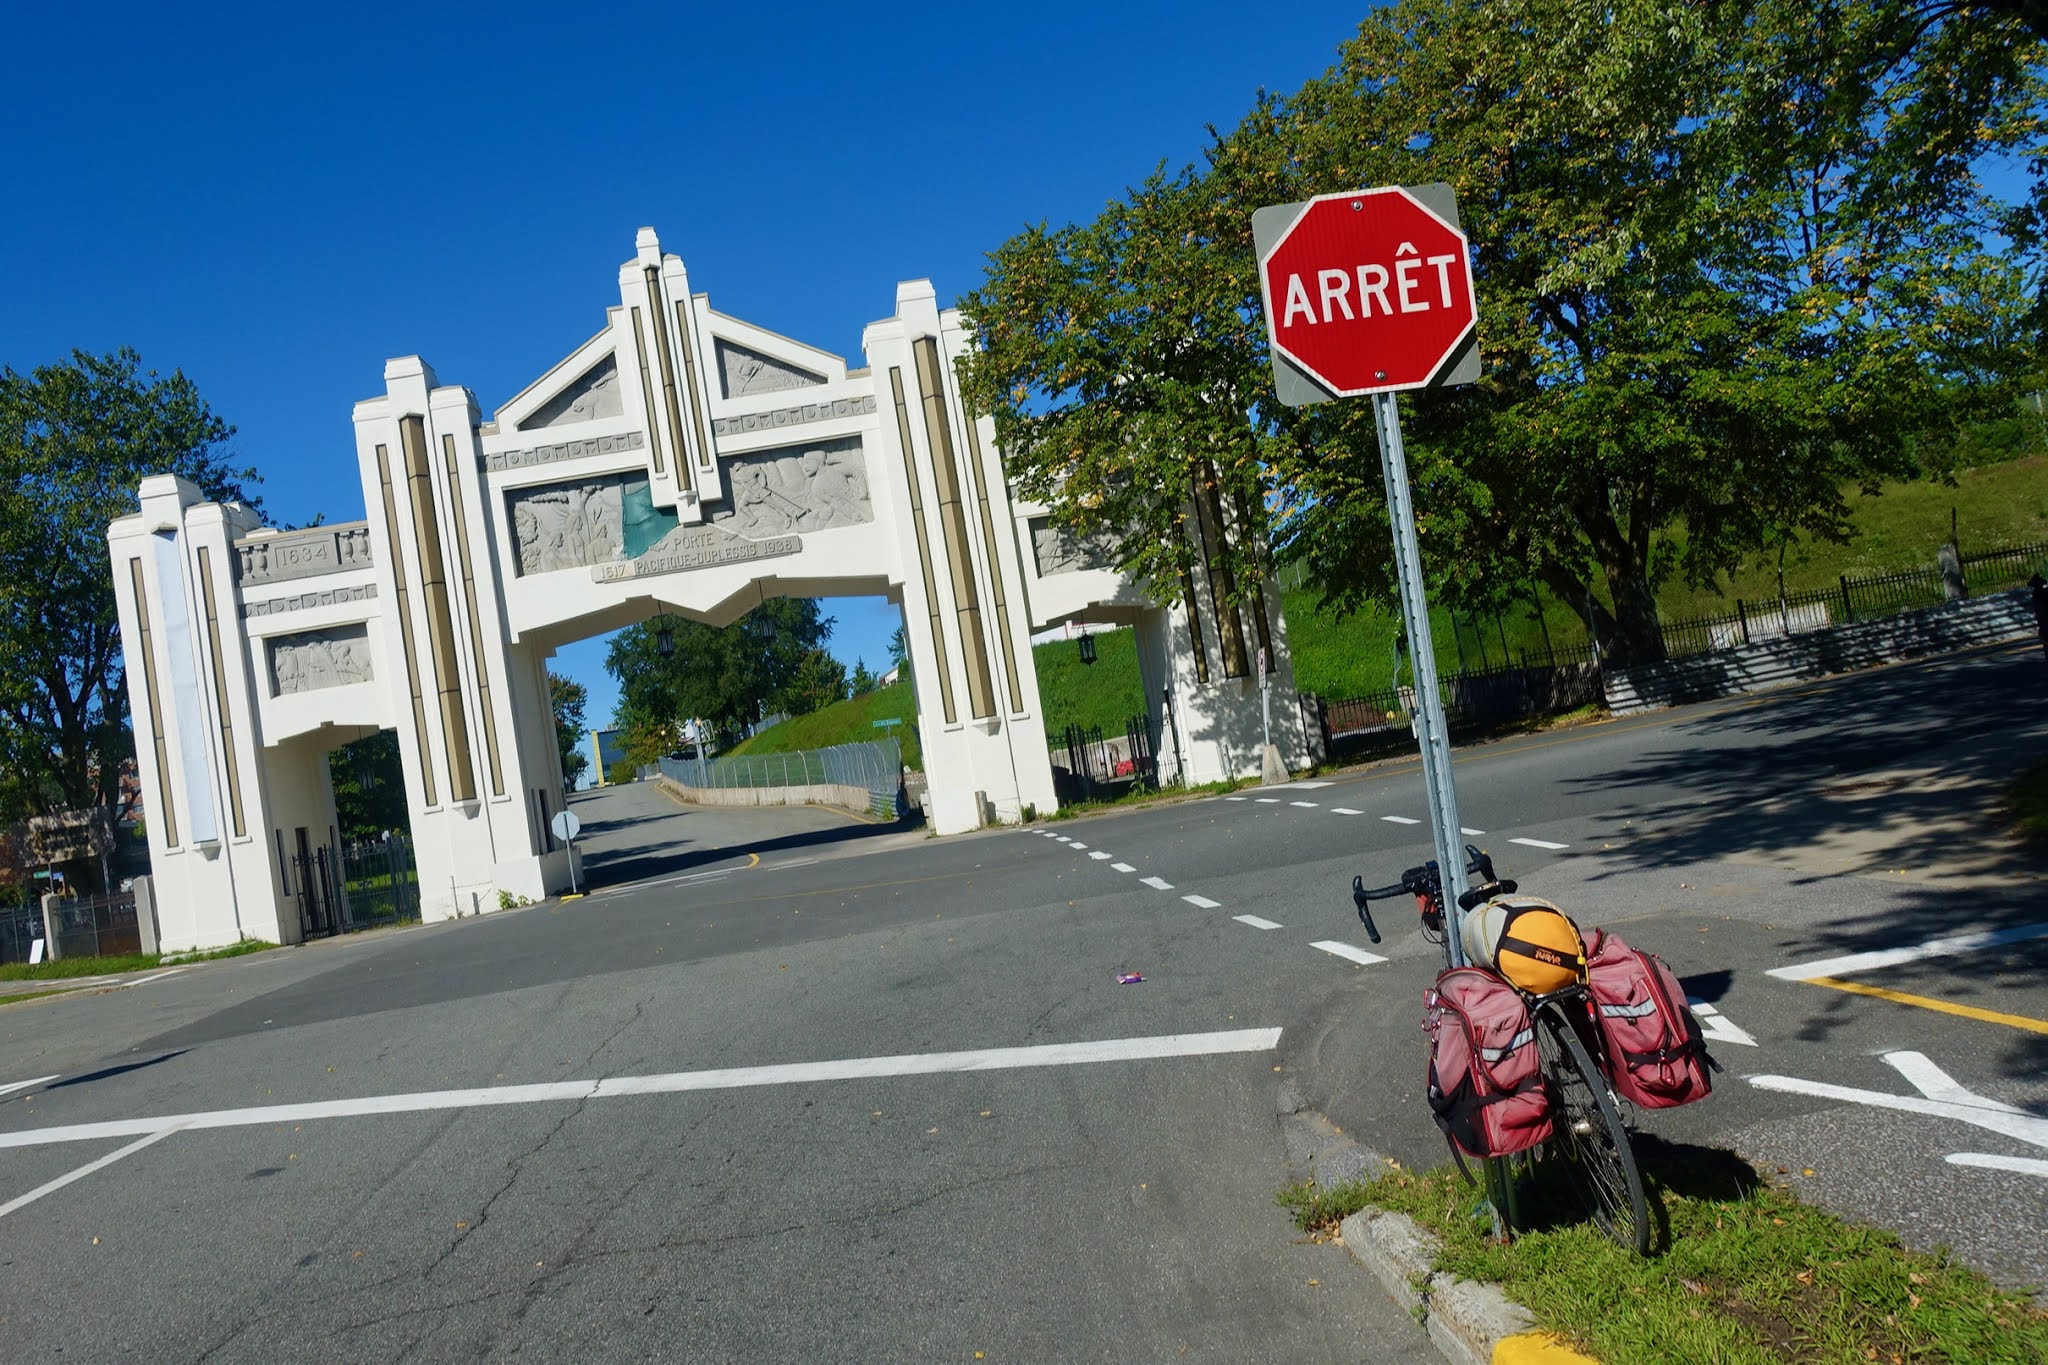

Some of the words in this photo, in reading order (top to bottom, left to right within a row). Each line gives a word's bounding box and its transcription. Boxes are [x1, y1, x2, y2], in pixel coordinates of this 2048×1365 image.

[1283, 241, 1456, 328] ARRÊT
[282, 544, 328, 566] 1634
[674, 533, 715, 551] PORTE
[636, 543, 757, 574] PACIFIQUE-DUPLESSIS
[764, 539, 793, 555] 1938
